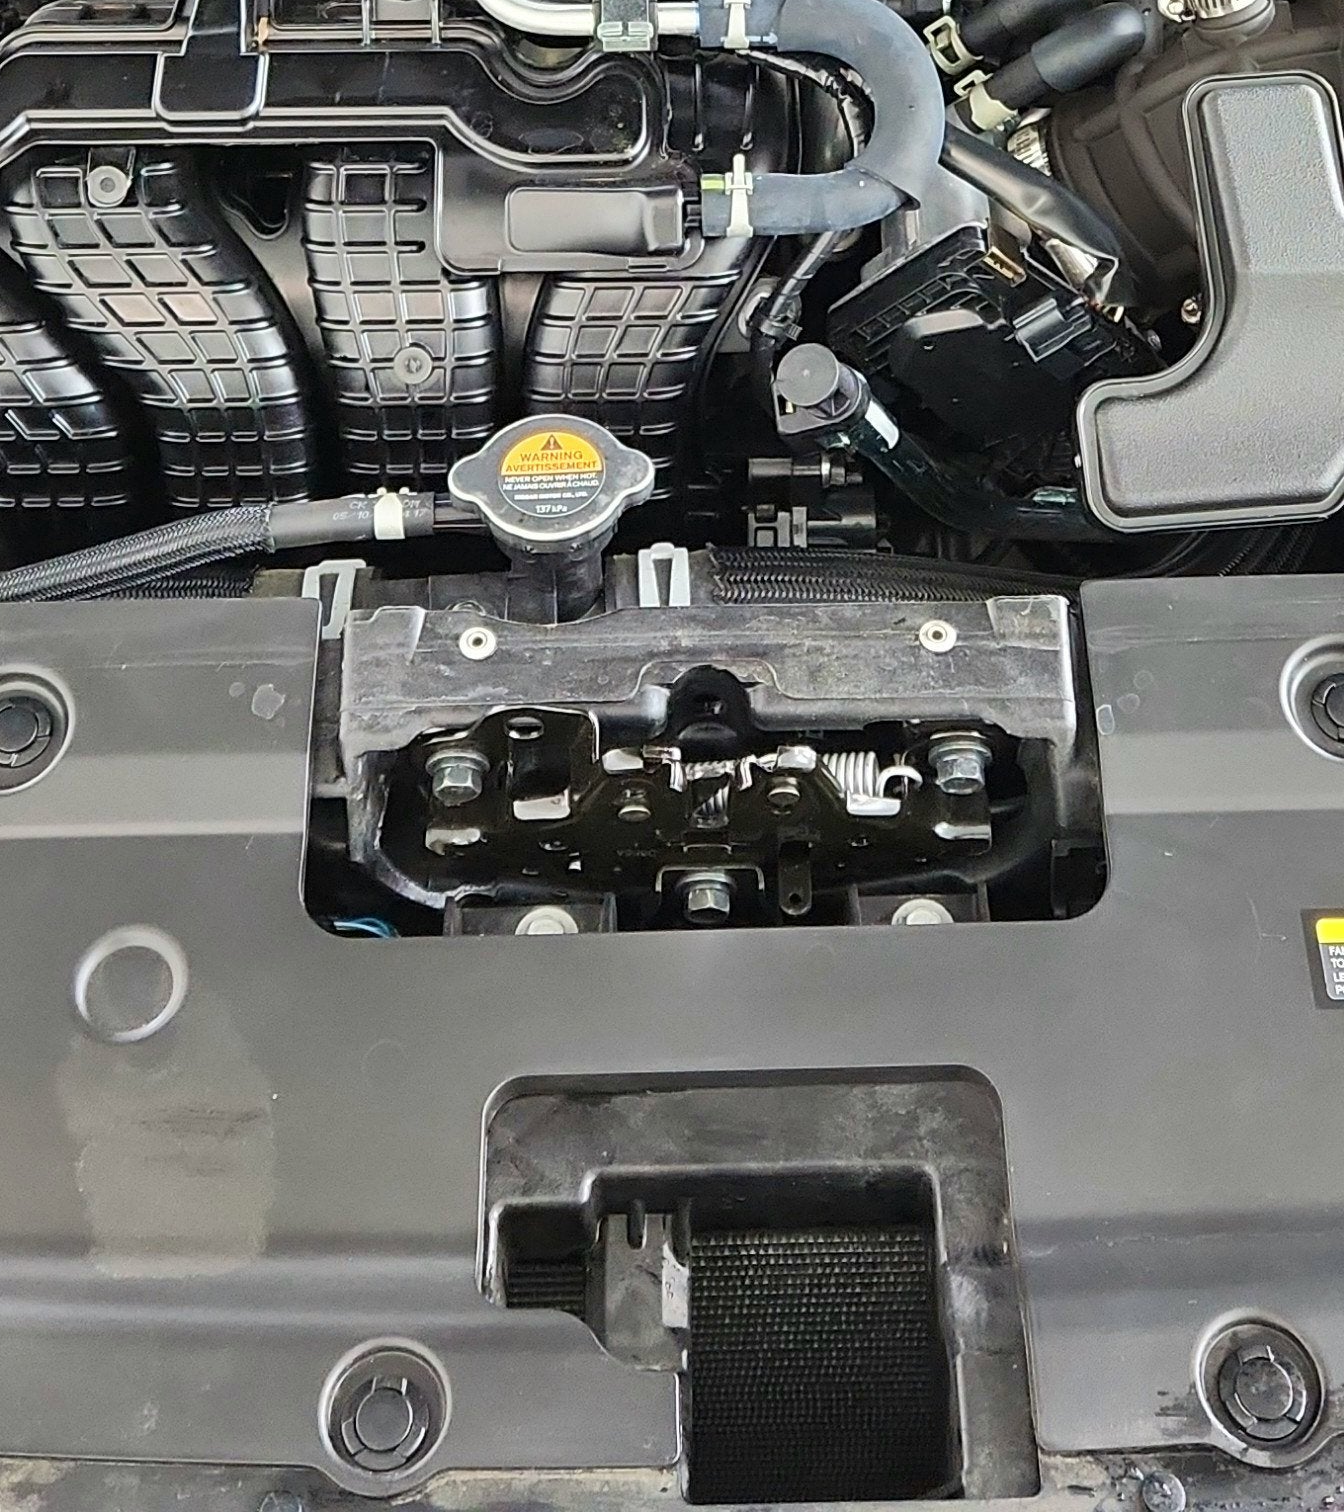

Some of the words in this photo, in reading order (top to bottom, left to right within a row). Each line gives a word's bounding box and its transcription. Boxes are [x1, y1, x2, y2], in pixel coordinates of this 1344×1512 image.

[520, 451, 583, 462] WARNING
[506, 461, 597, 472] AVERTISSEMENT
[532, 475, 554, 483] OPEN
[555, 473, 579, 482] WHEN
[539, 482, 566, 490] OUVRIR
[536, 504, 551, 514] 137
